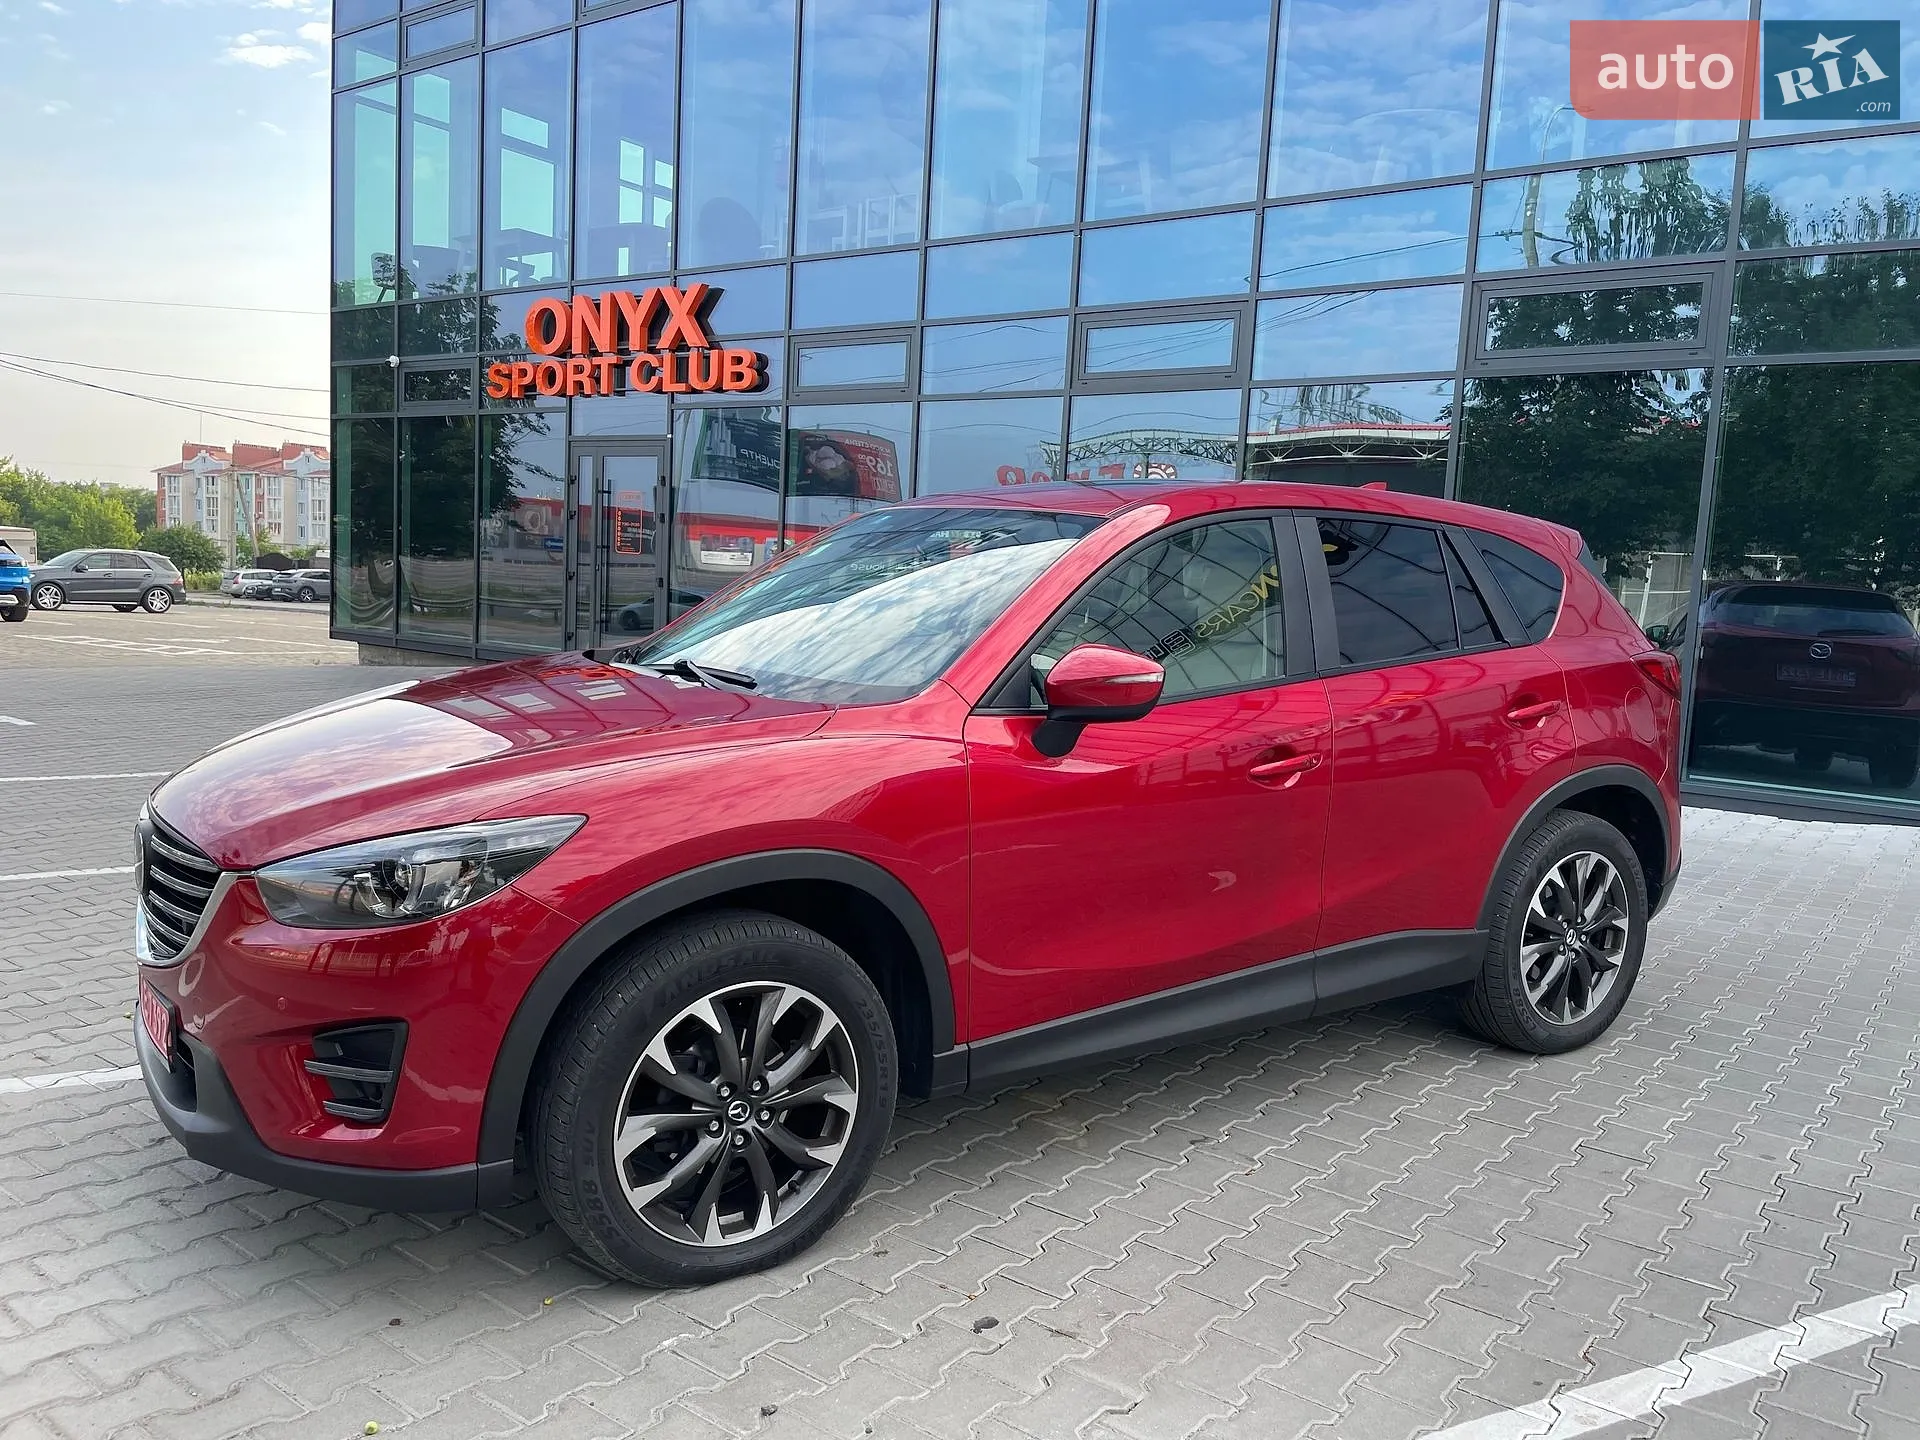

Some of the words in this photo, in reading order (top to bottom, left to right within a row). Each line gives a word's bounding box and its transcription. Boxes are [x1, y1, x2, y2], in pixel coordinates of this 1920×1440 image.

[524, 283, 710, 355] ONYX
[486, 356, 622, 399] SPORT
[629, 348, 758, 393] CLUB
